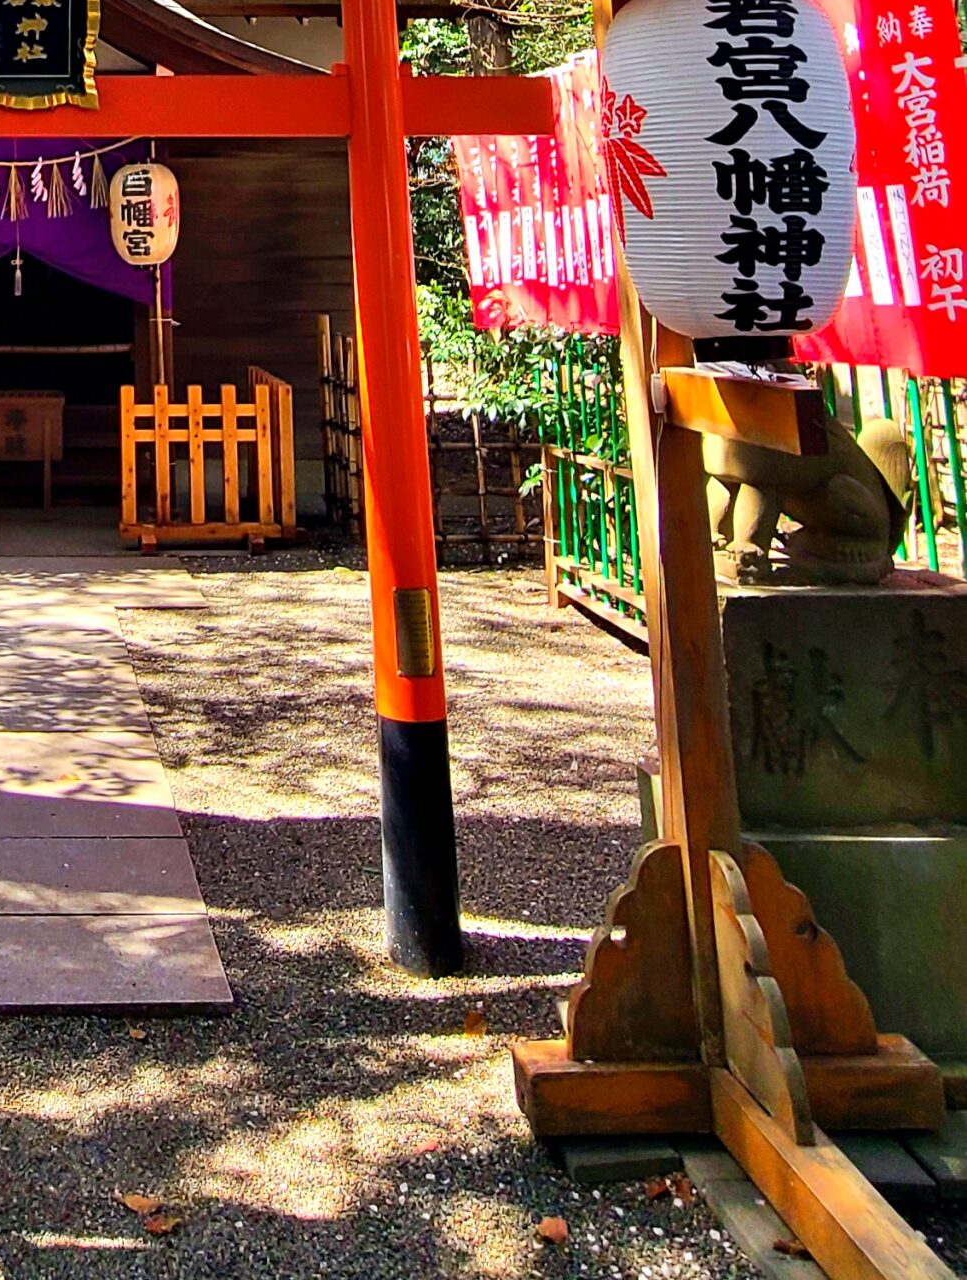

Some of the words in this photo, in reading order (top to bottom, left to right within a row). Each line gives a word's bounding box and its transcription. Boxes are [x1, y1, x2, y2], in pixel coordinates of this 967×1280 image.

[891, 51, 951, 208] 大宮稲荷
[921, 243, 967, 322] 初午
